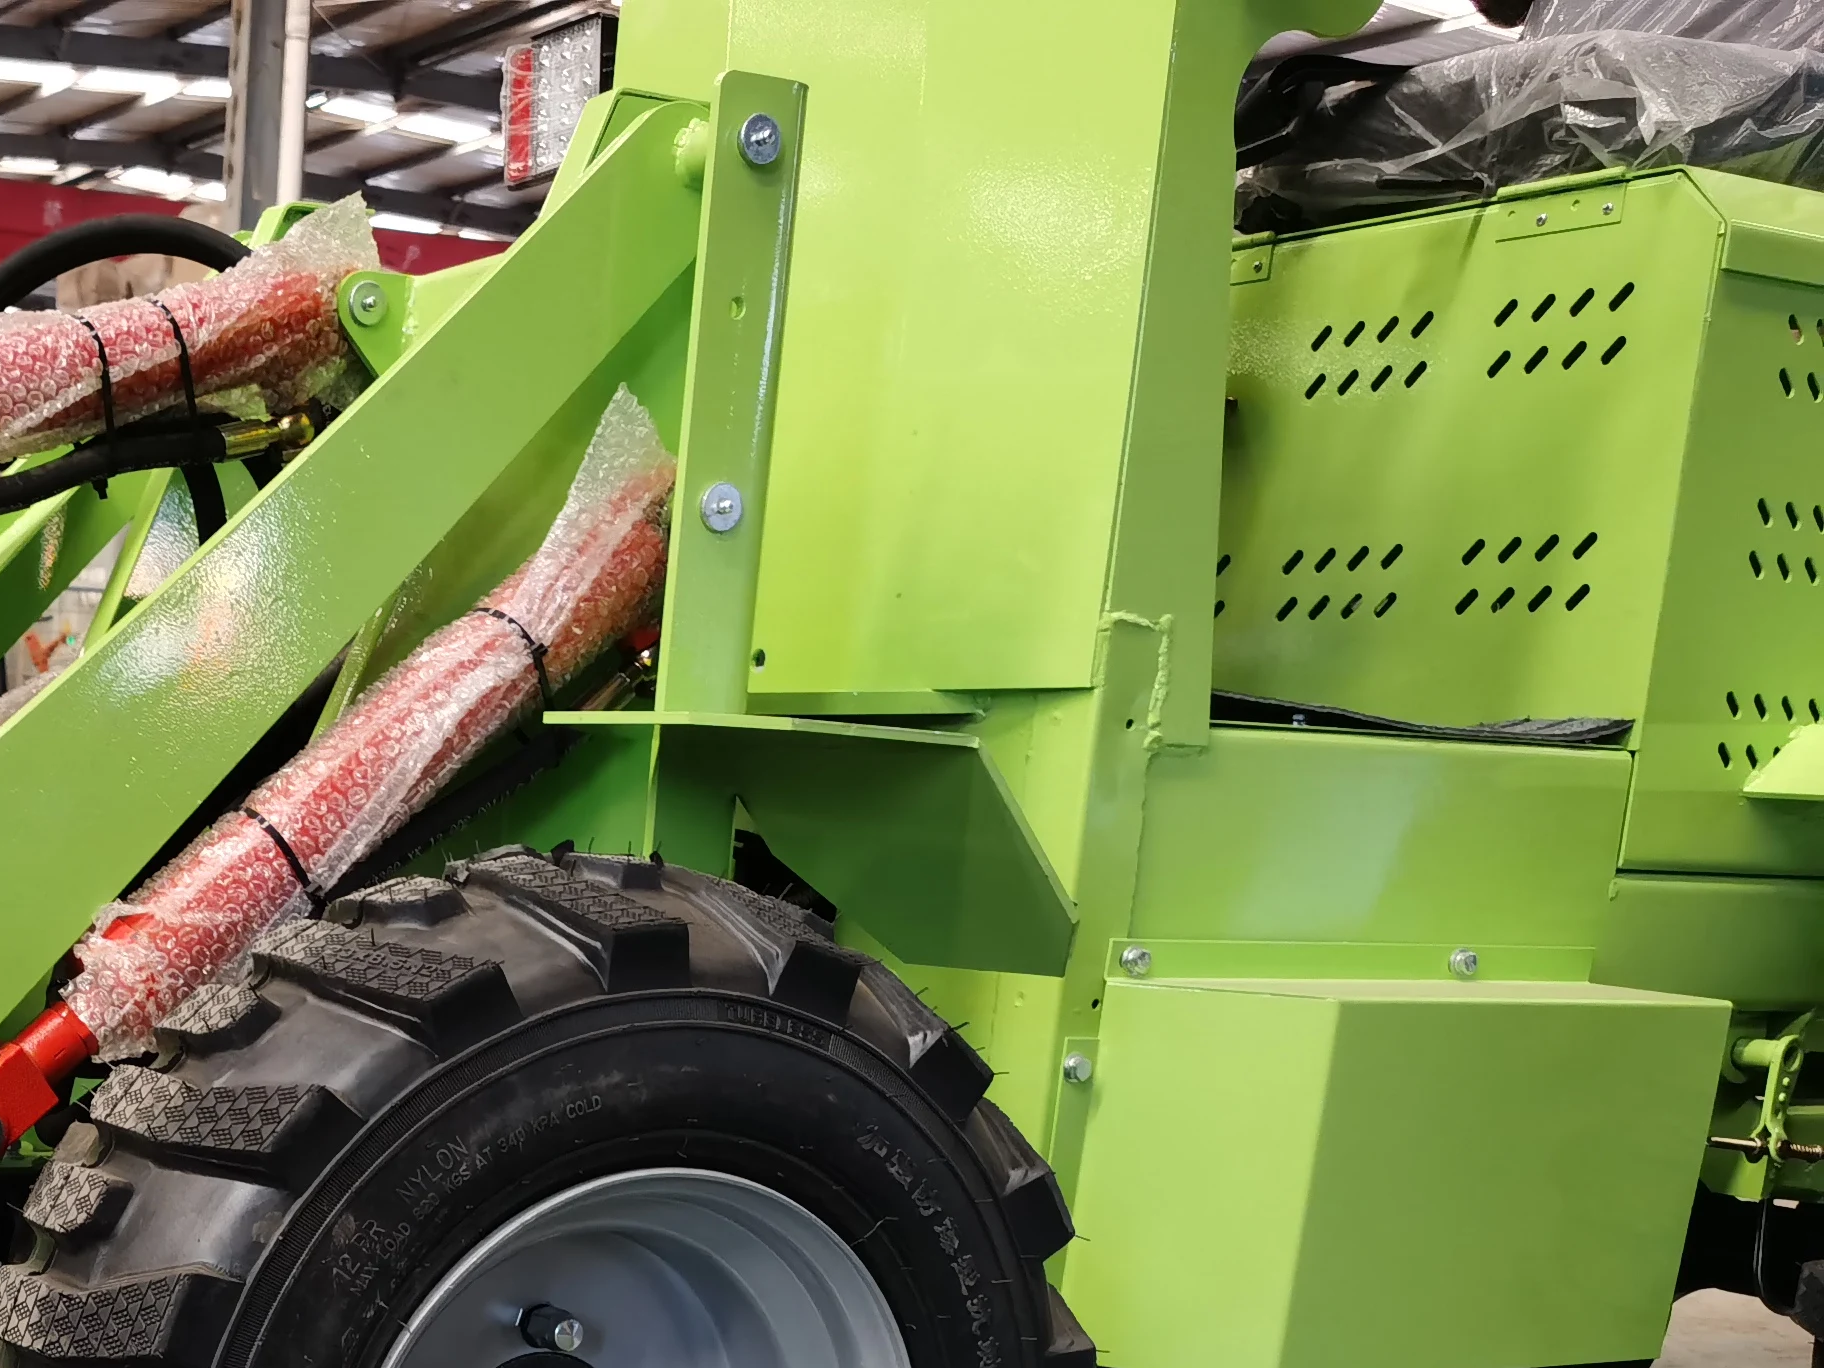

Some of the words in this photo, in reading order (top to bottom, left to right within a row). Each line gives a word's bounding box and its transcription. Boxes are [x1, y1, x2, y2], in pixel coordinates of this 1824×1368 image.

[376, 1221, 412, 1261] LOAD
[475, 1145, 494, 1171] AT
[564, 1094, 604, 1120] COLD
[395, 1135, 470, 1204] NYLON
